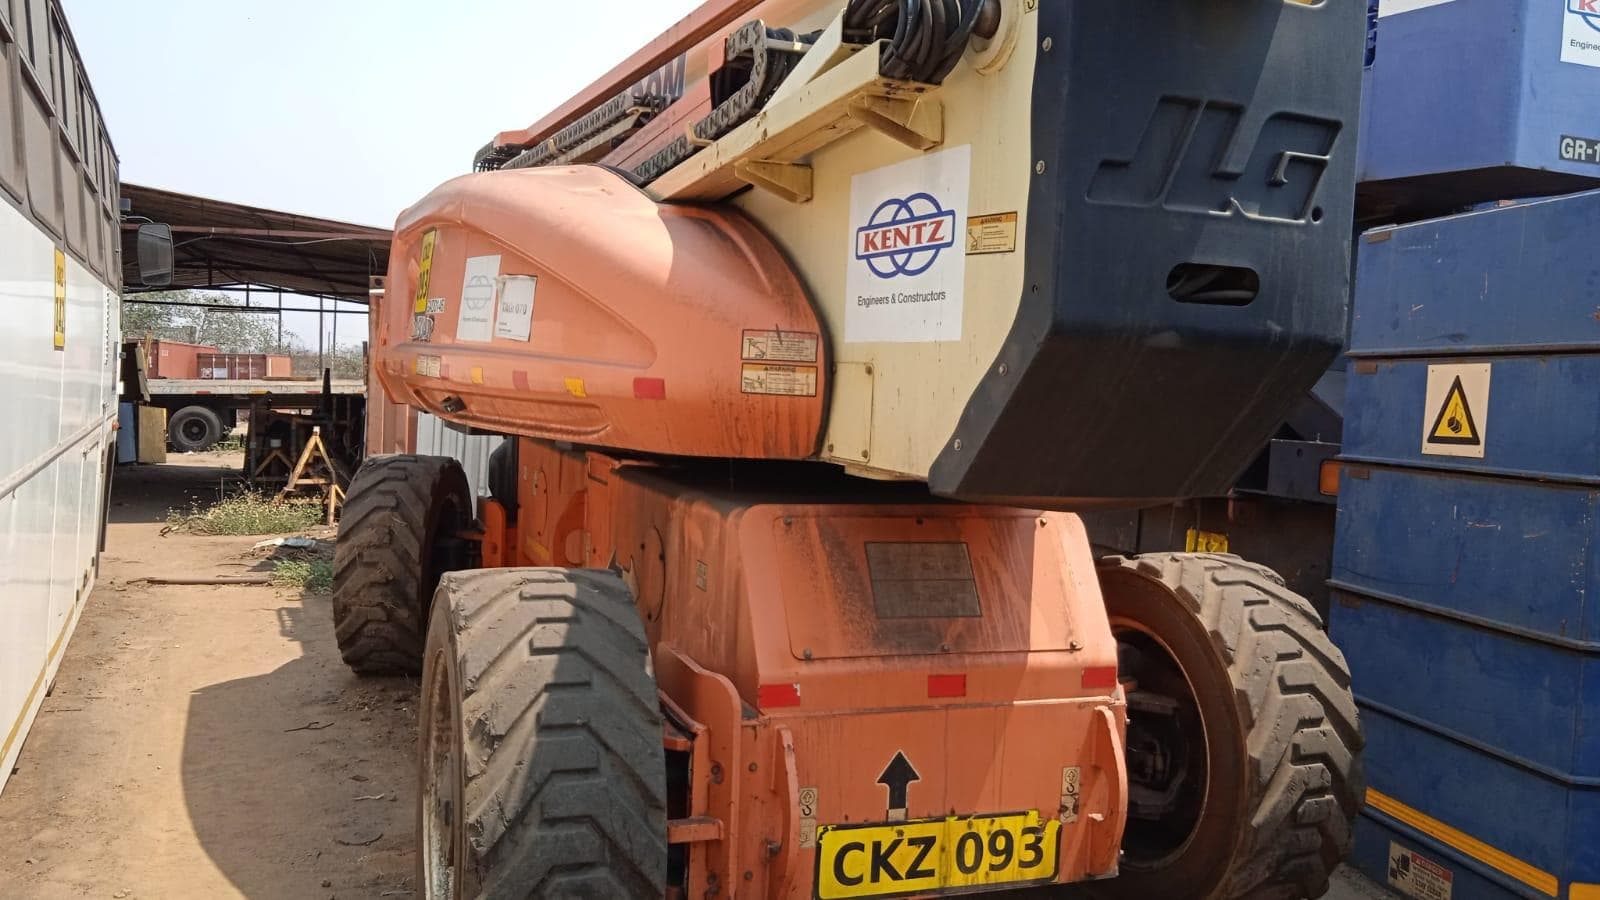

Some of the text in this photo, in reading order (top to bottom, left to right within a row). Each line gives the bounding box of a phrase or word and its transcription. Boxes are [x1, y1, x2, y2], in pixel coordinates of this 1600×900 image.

[1084, 93, 1343, 226] JLG
[863, 219, 945, 253] KENTZ
[857, 290, 946, 308] Engineers & Constructors
[833, 826, 1045, 888] CKZ 093
